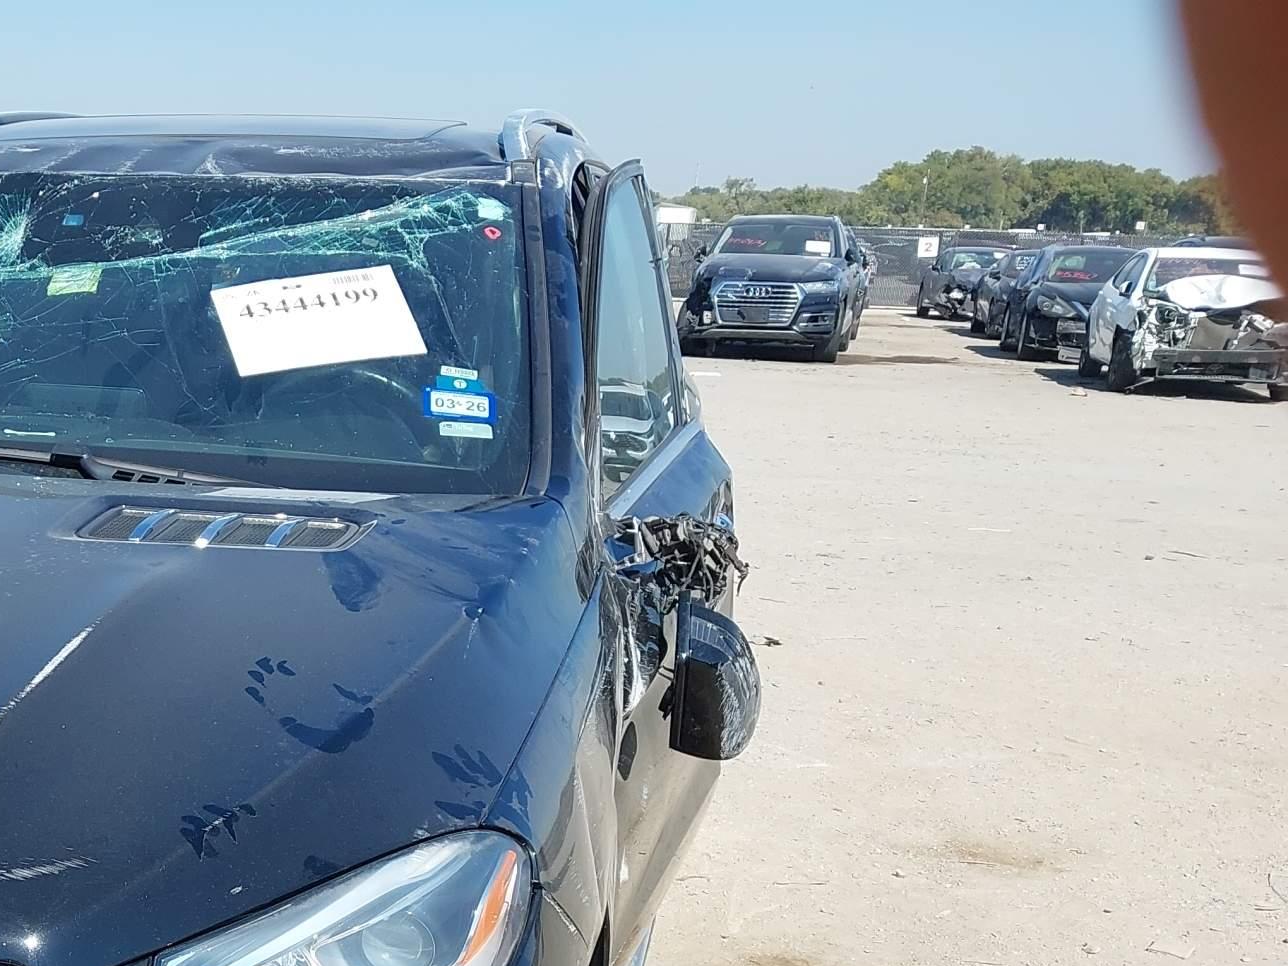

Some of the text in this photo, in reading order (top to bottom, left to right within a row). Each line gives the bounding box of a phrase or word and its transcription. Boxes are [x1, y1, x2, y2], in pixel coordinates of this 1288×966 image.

[924, 242, 933, 252] 2
[239, 287, 379, 319] 43444199
[435, 397, 487, 413] 03 26
